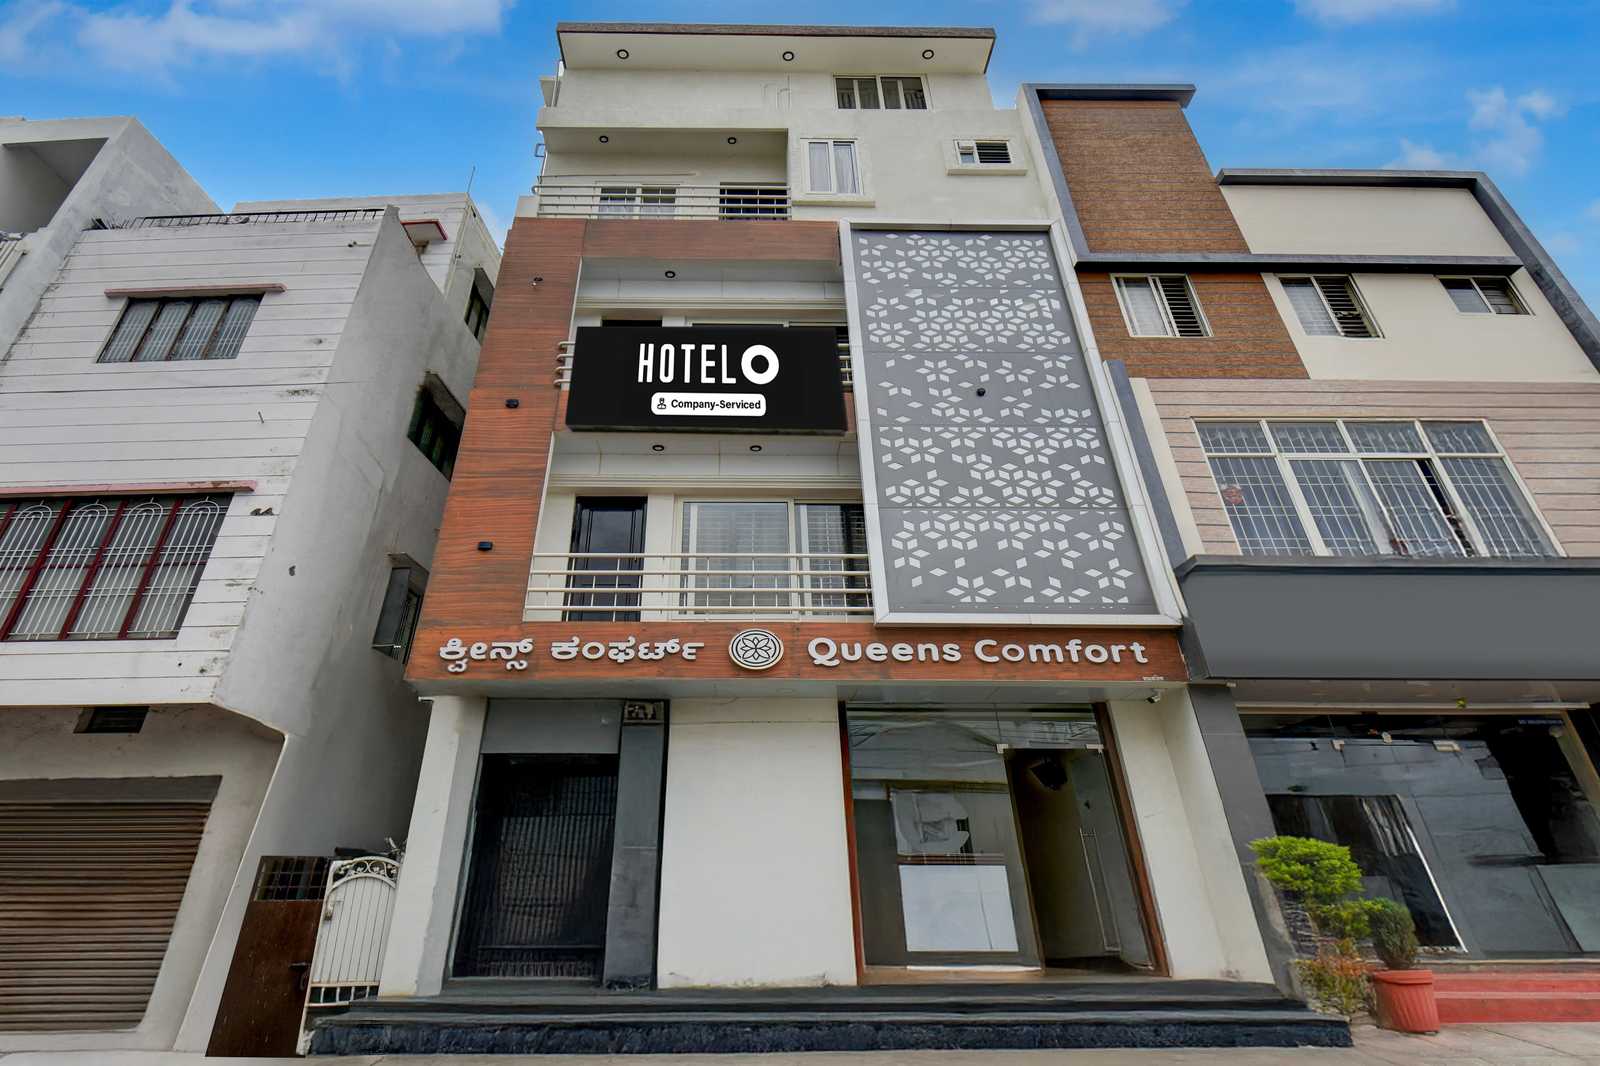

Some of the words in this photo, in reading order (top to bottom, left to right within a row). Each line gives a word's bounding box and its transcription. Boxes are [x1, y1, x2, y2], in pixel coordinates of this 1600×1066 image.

[637, 343, 737, 384] HOTEL
[740, 344, 780, 385] O
[670, 398, 762, 411] Company-Serviced
[438, 637, 534, 673] ಕ್ವೀನ್ಸ್
[807, 637, 962, 667] Queens
[973, 638, 1149, 664] Comfort
